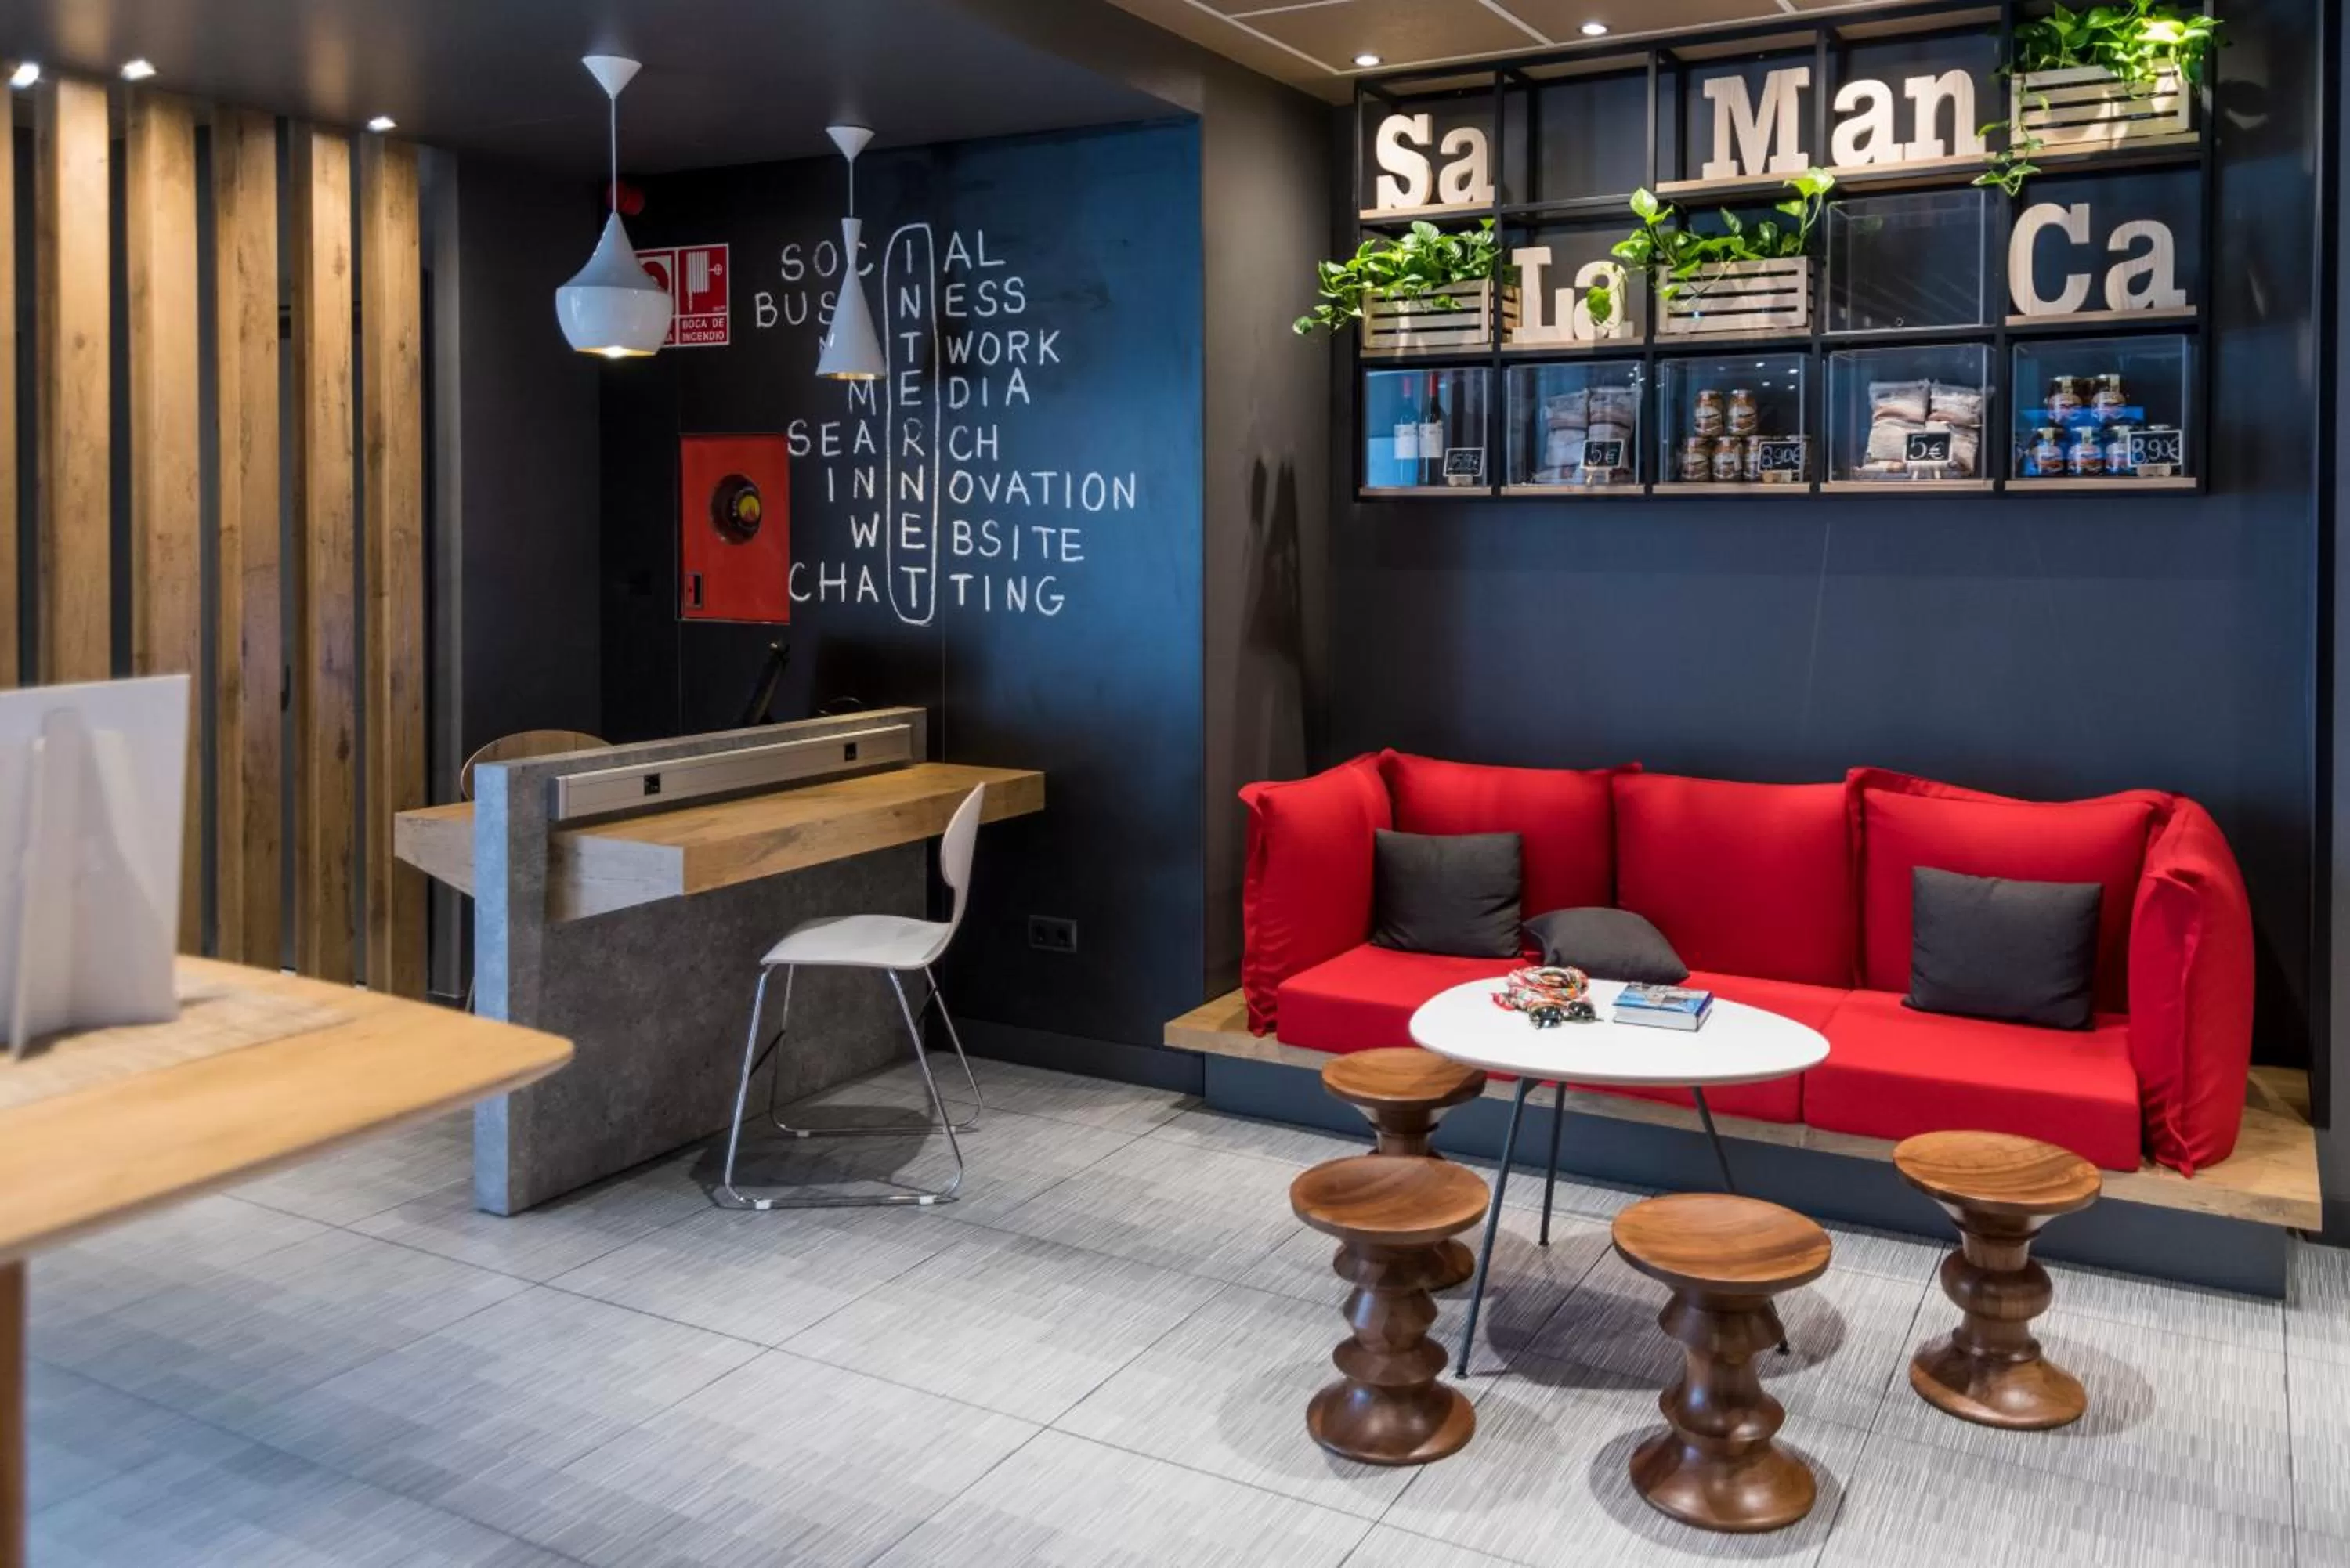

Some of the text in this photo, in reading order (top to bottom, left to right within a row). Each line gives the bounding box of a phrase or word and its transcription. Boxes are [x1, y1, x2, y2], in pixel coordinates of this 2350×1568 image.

[1376, 113, 1495, 210] Sa
[1702, 67, 1997, 181] Man
[1512, 247, 1635, 344] La
[2008, 202, 2187, 316] Ca
[682, 318, 725, 329] BOCA DE
[682, 331, 725, 342] INCENDIO
